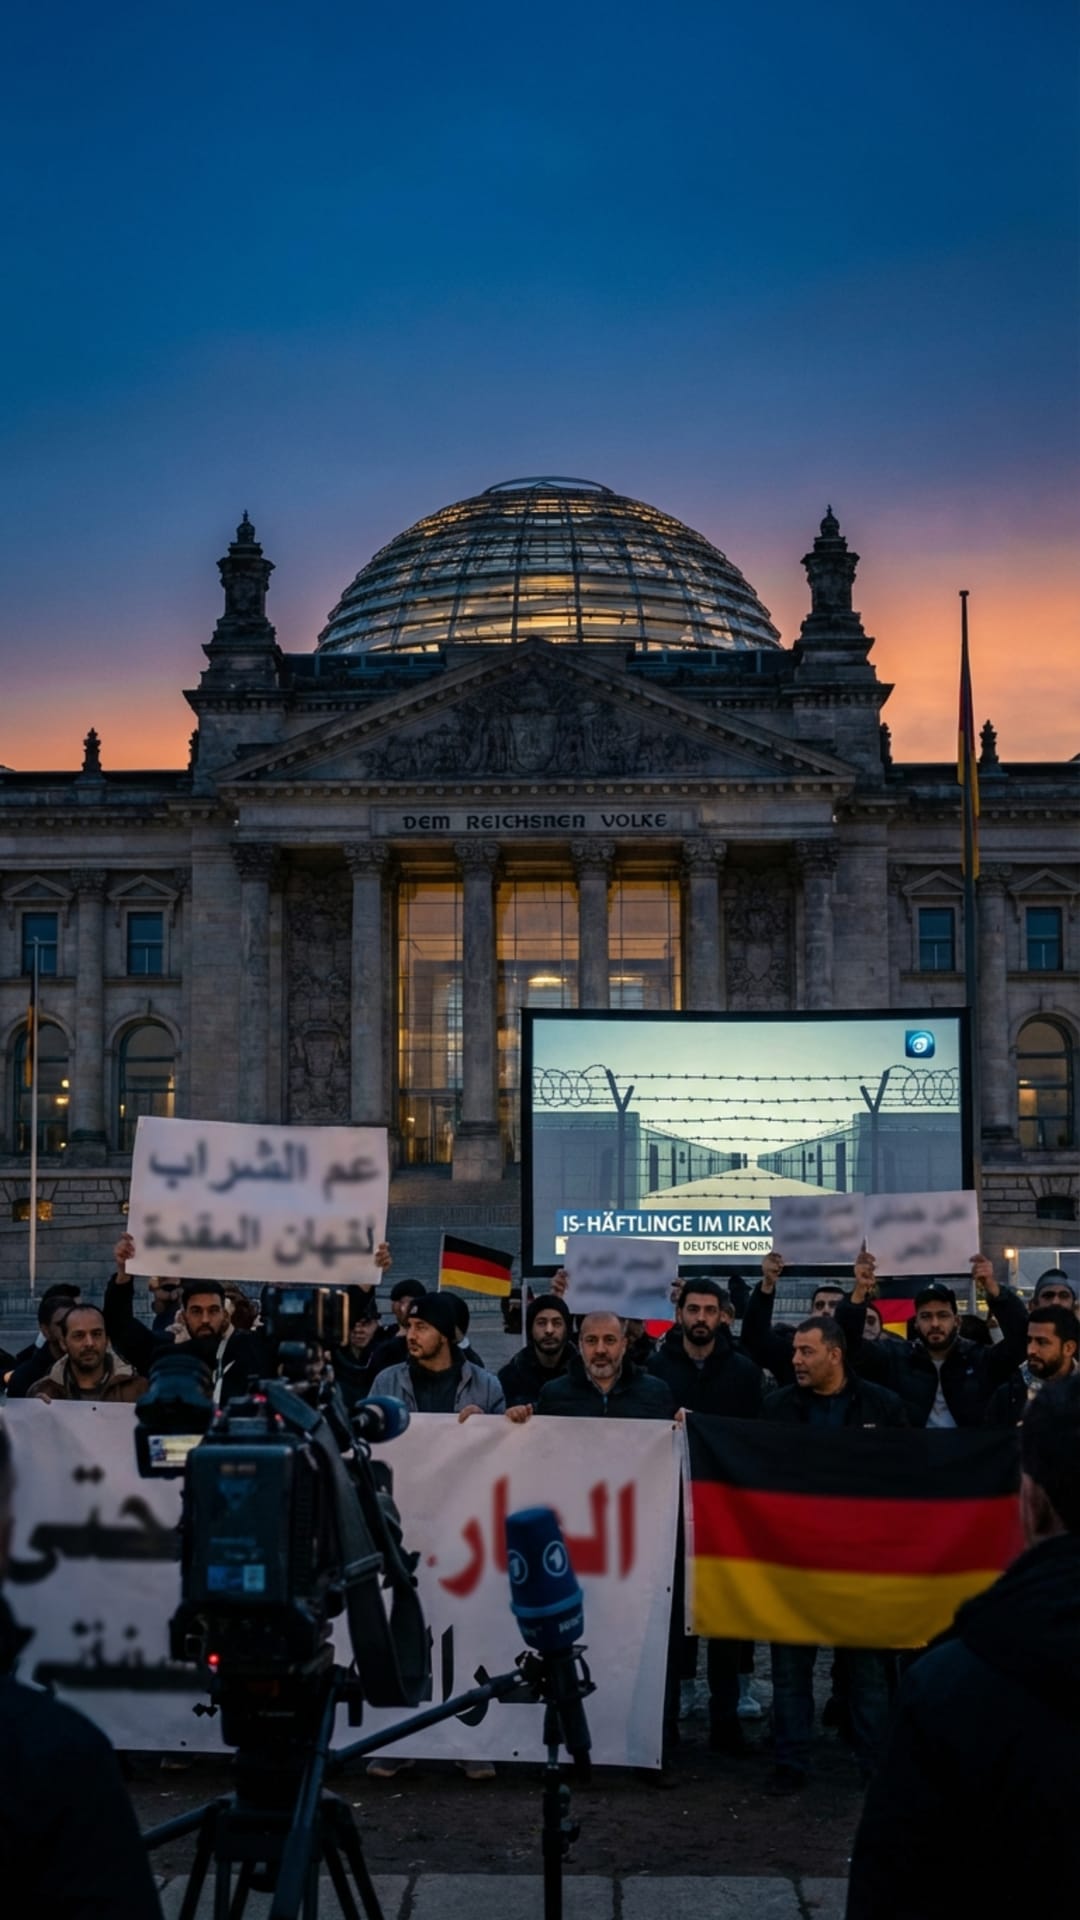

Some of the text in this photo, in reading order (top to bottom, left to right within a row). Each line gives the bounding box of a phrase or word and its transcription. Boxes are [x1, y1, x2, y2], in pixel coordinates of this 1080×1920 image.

[402, 815, 450, 830] DEM
[601, 813, 667, 829] VOLKE
[562, 1211, 773, 1233] IS-HÄFTLINGE IM IRAK
[683, 1240, 740, 1252] DEUTSCHE
